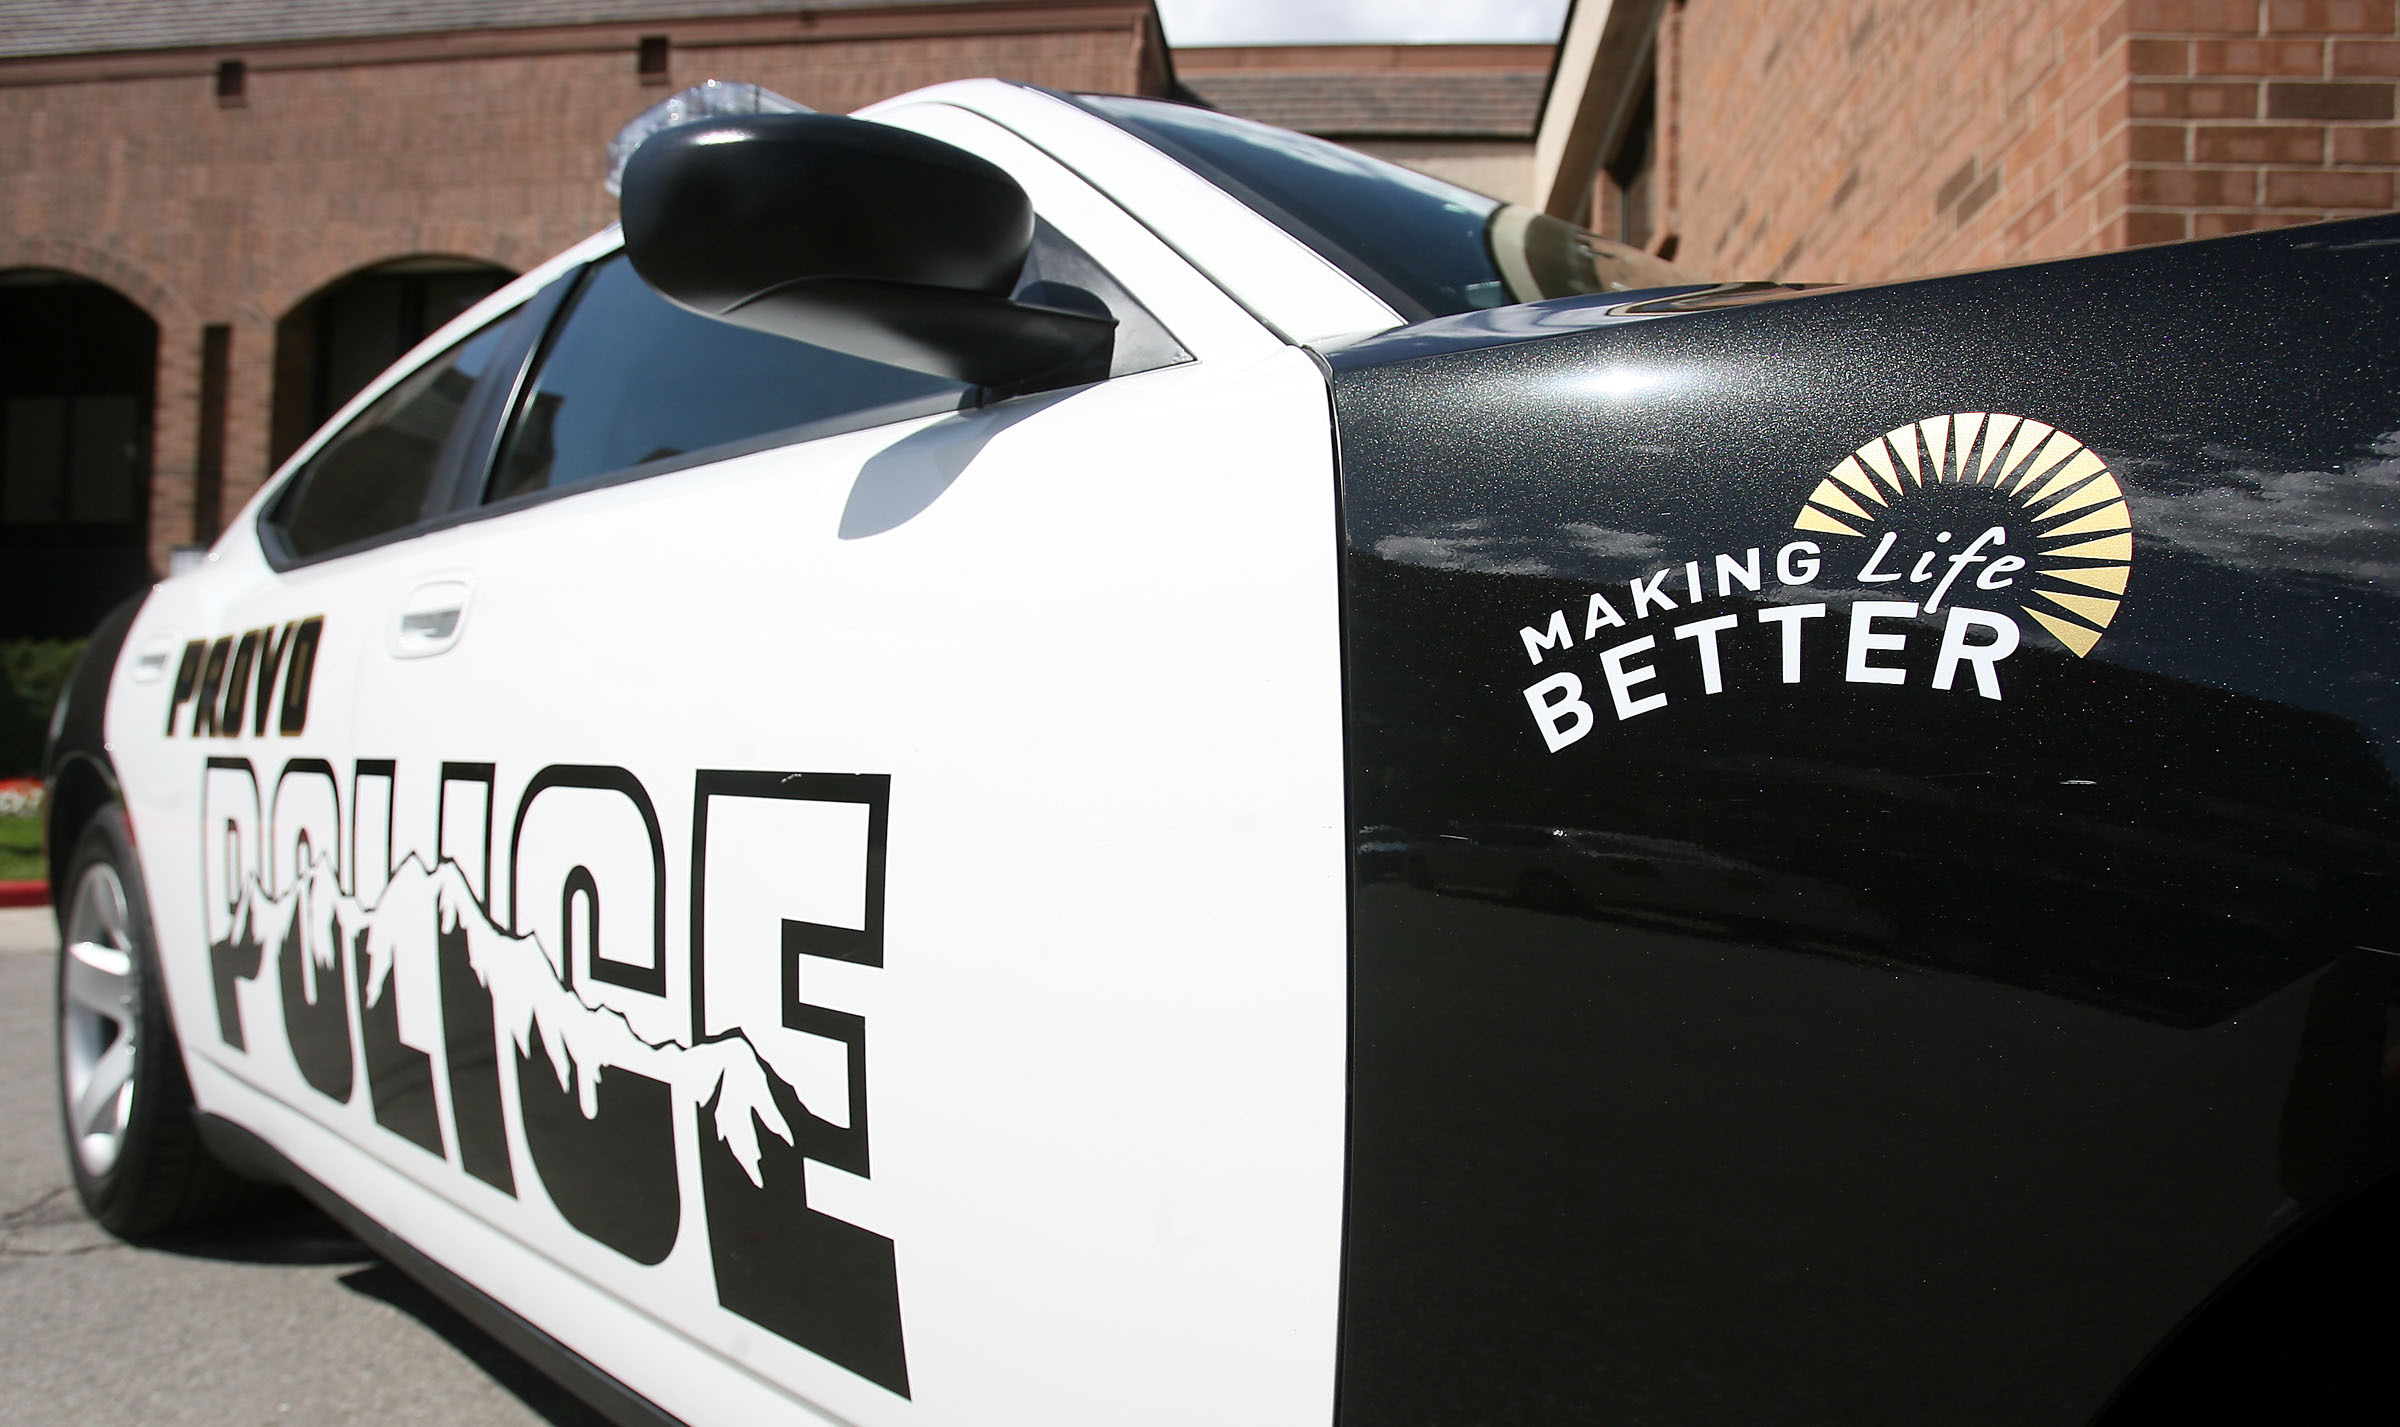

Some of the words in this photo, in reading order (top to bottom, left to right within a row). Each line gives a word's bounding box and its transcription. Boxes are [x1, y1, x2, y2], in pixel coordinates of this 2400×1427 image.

[1519, 541, 1821, 666] MAKING
[1857, 526, 2026, 614] Life
[165, 614, 325, 738] PROVO
[1522, 600, 2021, 755] BETTER
[203, 757, 912, 1402] POLICE
